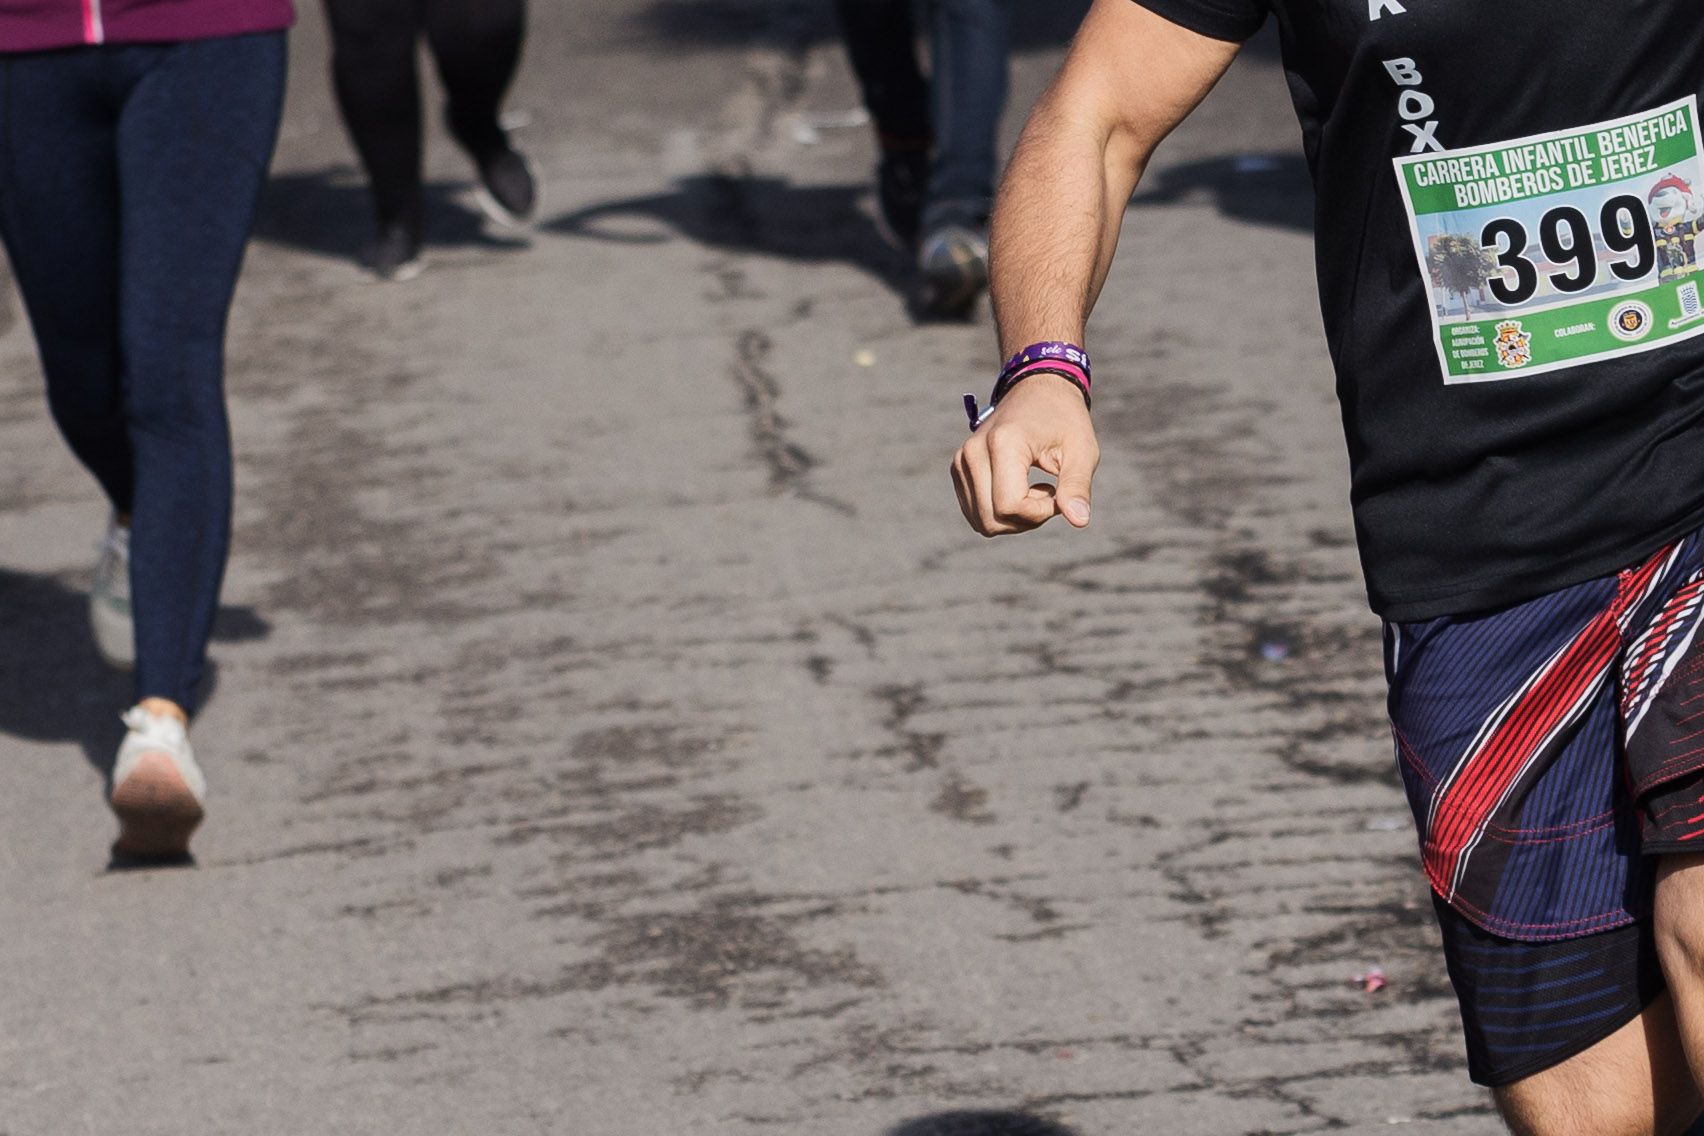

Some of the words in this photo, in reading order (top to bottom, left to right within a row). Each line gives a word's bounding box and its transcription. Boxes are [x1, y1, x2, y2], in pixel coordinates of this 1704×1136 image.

[1382, 57, 1446, 153] BOX
[1413, 154, 1500, 187] CARRERA
[1501, 136, 1595, 174] INFANTIL
[1597, 110, 1688, 153] BENÉFICA
[1453, 169, 1564, 207] BOMBEROS
[1568, 163, 1596, 187] DE
[1600, 145, 1658, 182] JEREZ
[1480, 194, 1657, 307] 399
